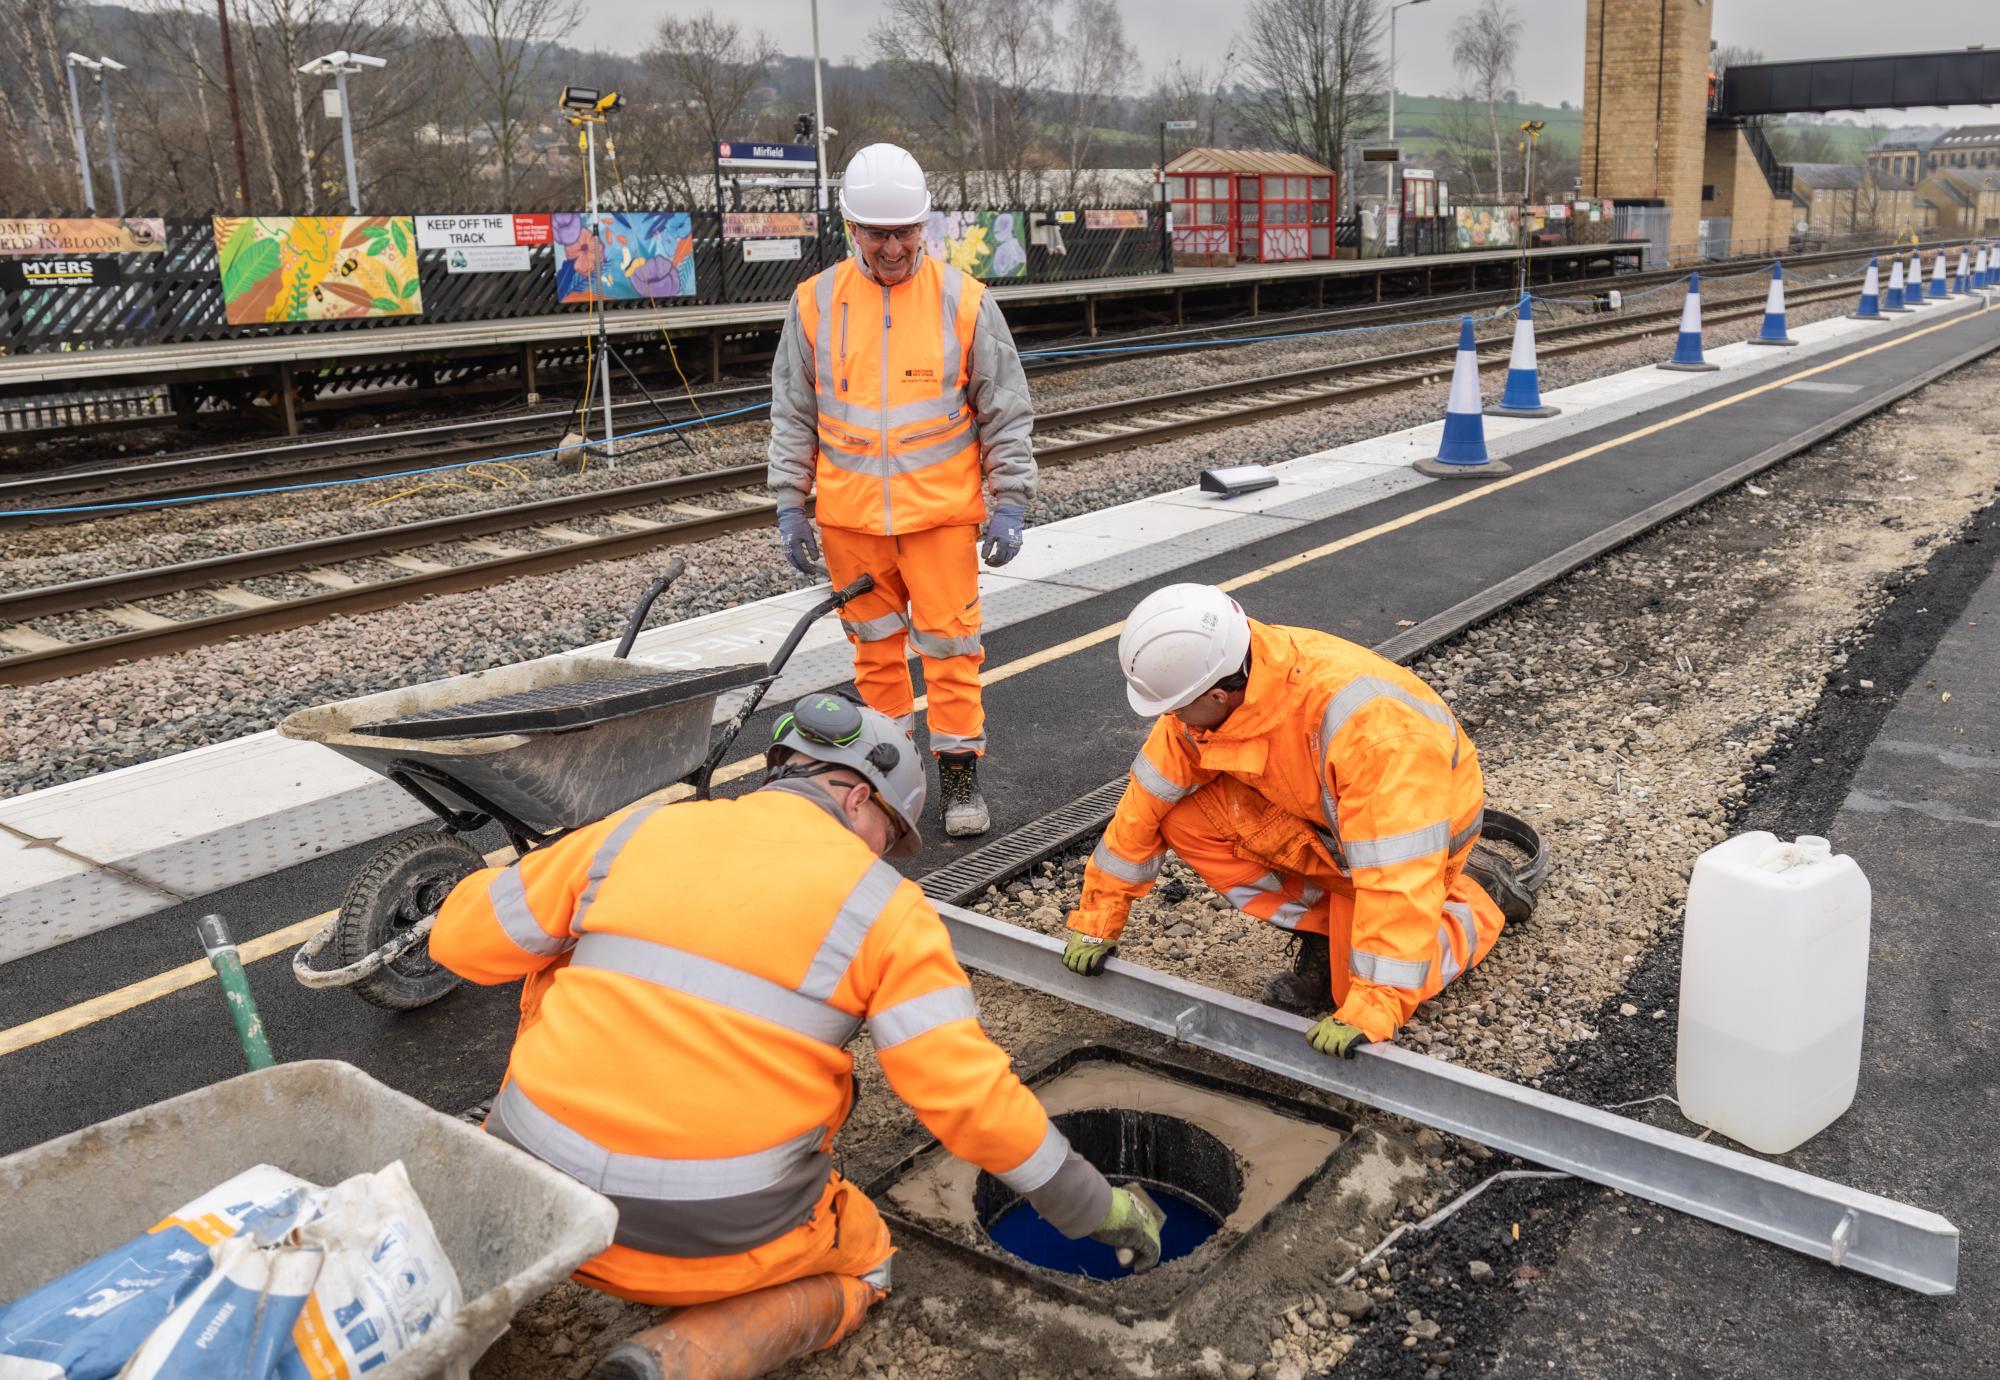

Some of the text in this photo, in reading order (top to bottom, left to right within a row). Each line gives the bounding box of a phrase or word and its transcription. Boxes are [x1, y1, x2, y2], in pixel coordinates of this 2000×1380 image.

[753, 146, 784, 158] Mirfield
[38, 223, 60, 235] TO
[427, 219, 456, 230] KEEP
[458, 219, 481, 229] OFF
[483, 218, 503, 229] THE
[39, 238, 57, 248] IN
[63, 236, 120, 248] BLOOM
[449, 233, 486, 244] TRACK
[21, 261, 94, 275] MYERS
[195, 1301, 237, 1349] POSTMIX
